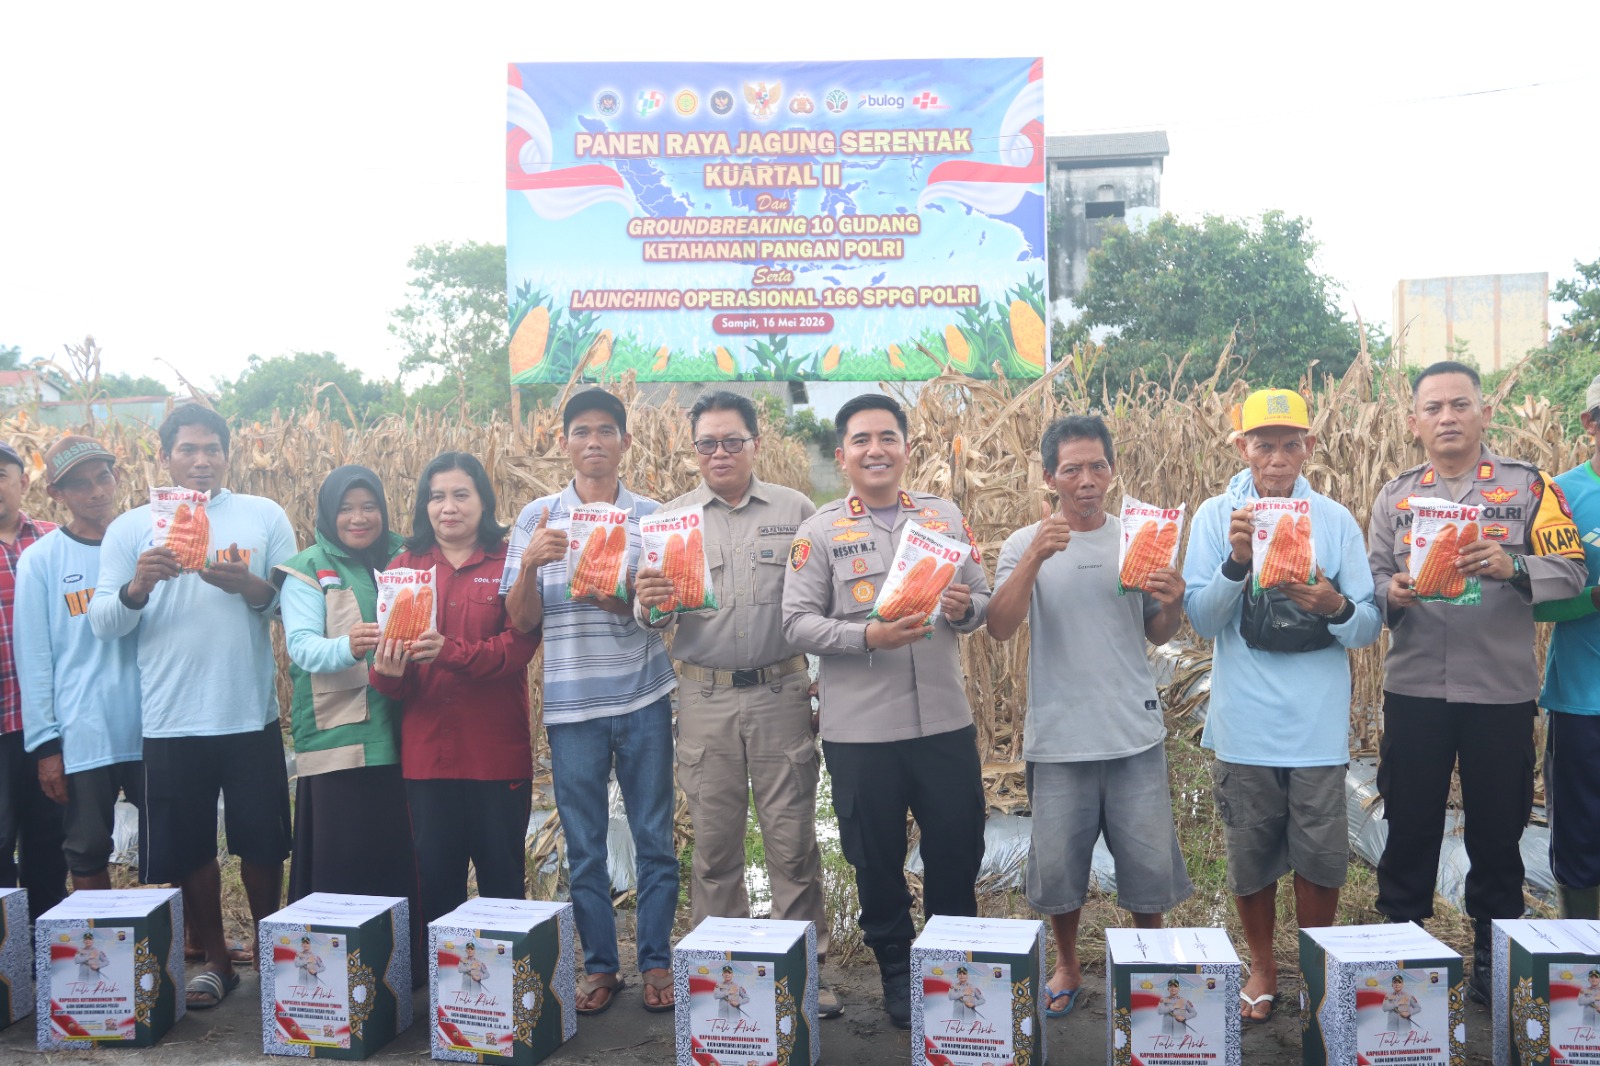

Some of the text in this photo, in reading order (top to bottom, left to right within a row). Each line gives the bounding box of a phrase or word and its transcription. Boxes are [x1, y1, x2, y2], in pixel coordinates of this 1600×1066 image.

[868, 94, 904, 109] bulog
[576, 129, 972, 156] PANEN RAYA JAGUNG SERENTAK
[705, 164, 840, 187] KUARTAL II
[757, 194, 788, 211] Dan
[629, 215, 919, 236] GROUNDBREAKING 10 GUDANG
[644, 240, 902, 260] KETAHANAN PANGAN POLRI
[753, 268, 793, 284] Serta
[572, 287, 977, 308] LAUNCHING OPERASIONAL 166 SPPG POLRI
[722, 317, 825, 329] Sampit, 16 Mei 2026
[52, 441, 101, 468] Masbro
[158, 492, 191, 501] BETRAS
[1125, 508, 1180, 520] BETRAS 10
[1256, 501, 1310, 514] BETRAS 10
[1419, 509, 1459, 519] BETRAS
[1460, 507, 1479, 521] 10
[1483, 506, 1522, 519] OLRI
[573, 511, 626, 525] BETRAS 10
[643, 522, 680, 533] BETRAS
[681, 513, 700, 530] 10
[1396, 513, 1414, 529] AN
[1542, 527, 1582, 553] KAPO
[832, 541, 877, 559] RESKY M.Z
[907, 534, 943, 556] BETRAS
[942, 548, 961, 563] 10
[415, 571, 432, 584] 10
[940, 1020, 996, 1035] Tali Asih
[1568, 1026, 1596, 1042] Tali
[1148, 1034, 1208, 1050] Tali Asih
[1374, 1030, 1432, 1047] Tali Asih
